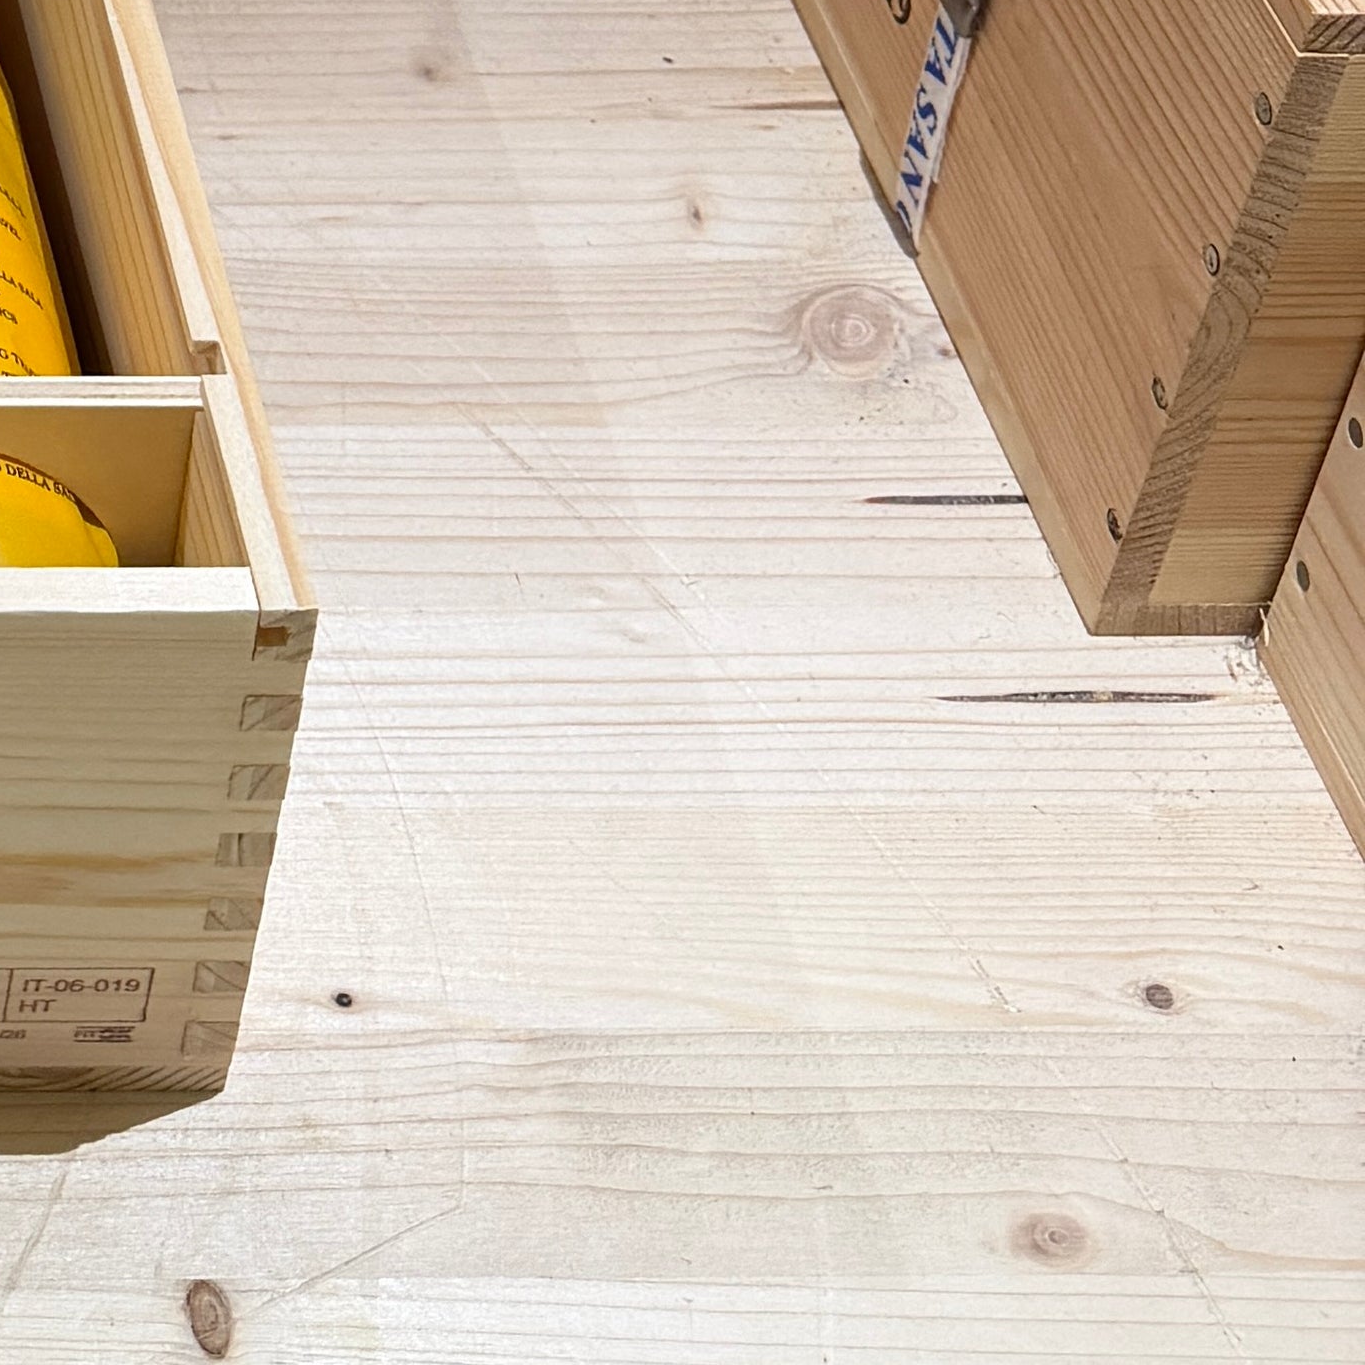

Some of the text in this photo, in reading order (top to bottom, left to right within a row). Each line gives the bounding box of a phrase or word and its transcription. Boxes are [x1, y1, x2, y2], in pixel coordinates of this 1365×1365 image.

[5, 462, 52, 491] DELLA
[23, 979, 140, 992] IT-06-019
[19, 999, 55, 1012] HT
